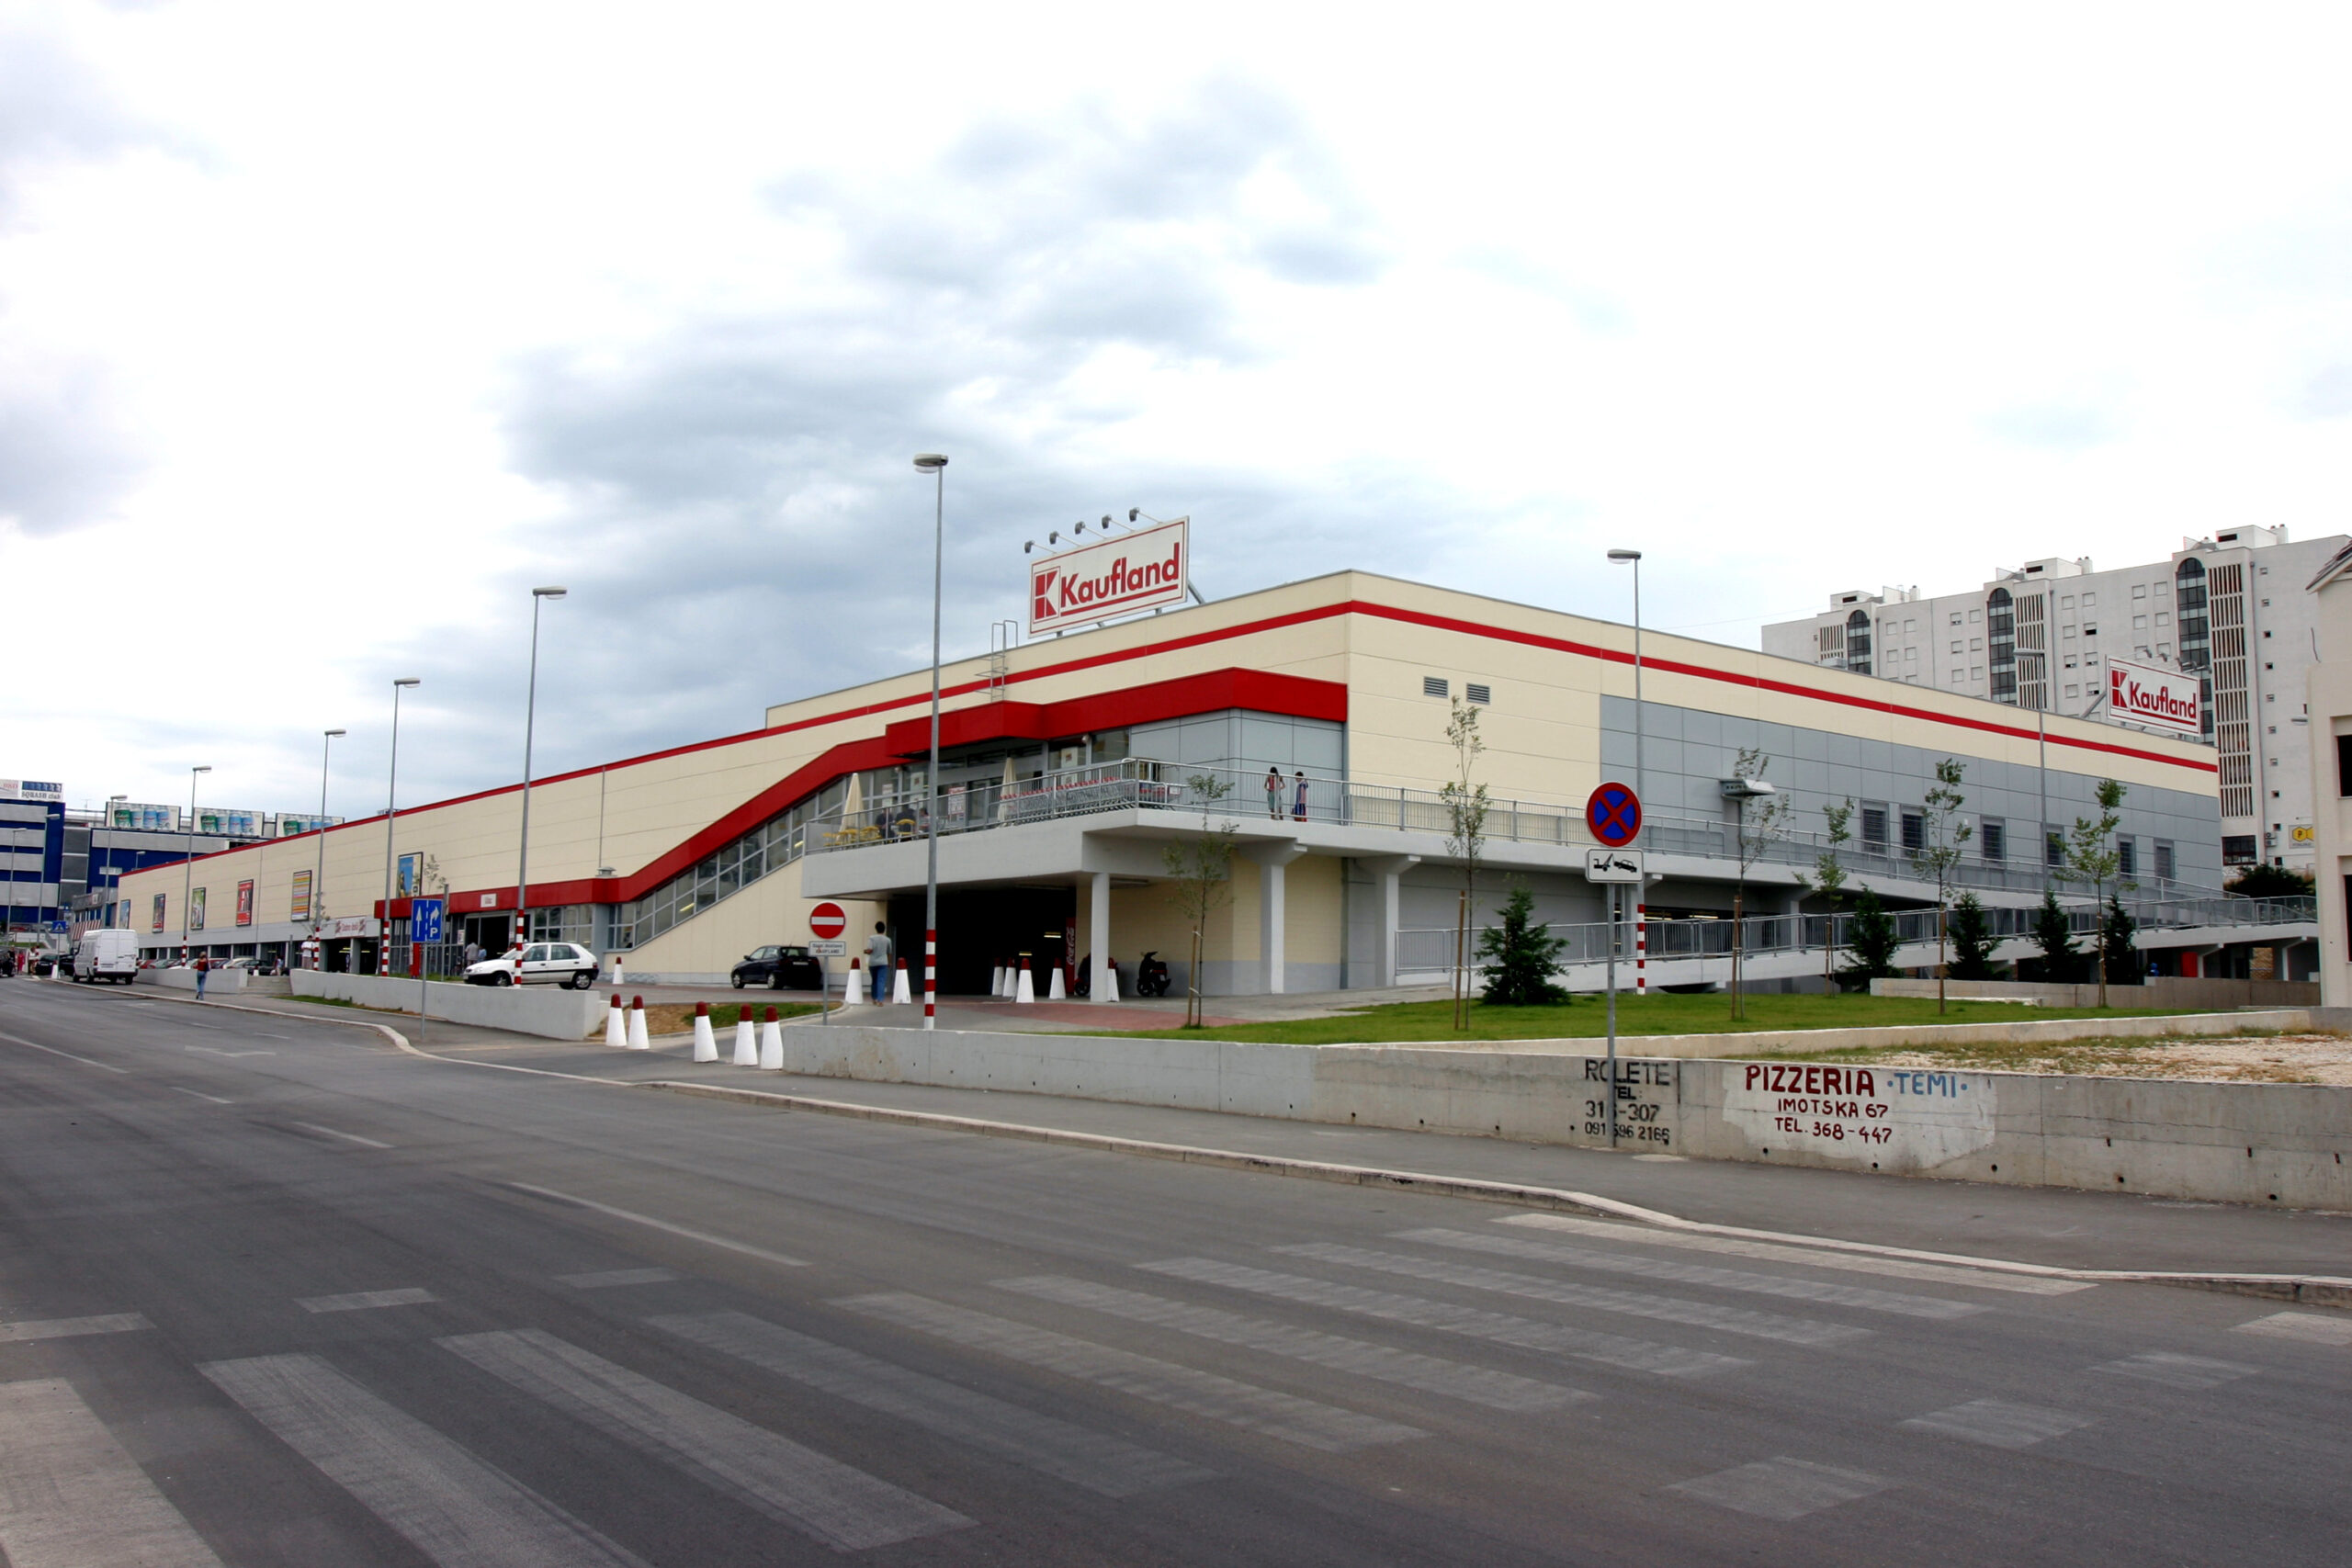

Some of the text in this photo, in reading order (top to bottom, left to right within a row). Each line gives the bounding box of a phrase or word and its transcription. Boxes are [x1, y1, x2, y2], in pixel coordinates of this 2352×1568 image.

[1060, 542, 1180, 608] Kaufland
[2130, 681, 2197, 719] Kaufland
[430, 927, 438, 938] P
[1585, 1059, 1669, 1085] ROLETE
[1745, 1065, 1875, 1098] PIZZERIA
[1778, 1099, 1888, 1118] IMOTSKA 67
[1585, 1122, 1606, 1135] 091
[1774, 1117, 1893, 1145] TEL. 368-447
